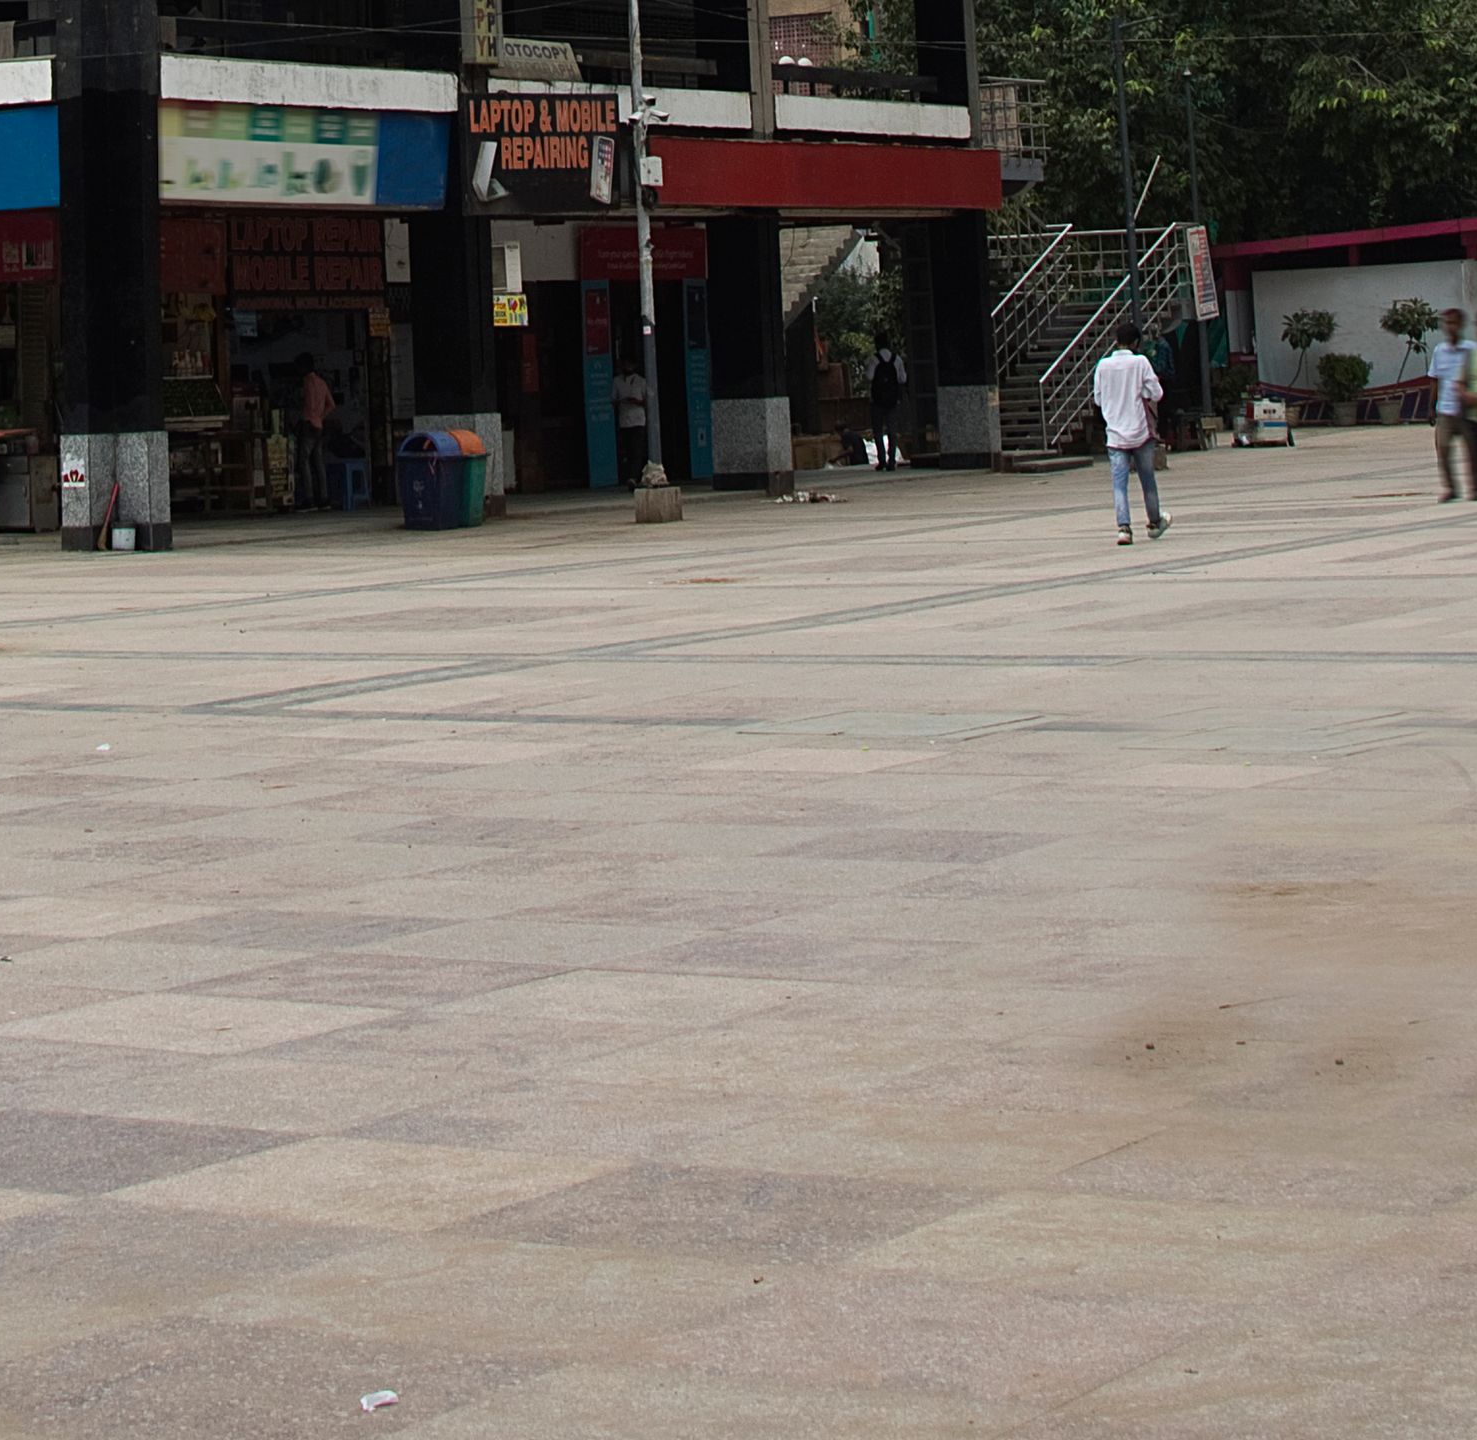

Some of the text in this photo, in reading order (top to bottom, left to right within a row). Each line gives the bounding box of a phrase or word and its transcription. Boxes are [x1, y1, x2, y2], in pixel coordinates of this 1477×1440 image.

[505, 43, 568, 59] OTOCOPY
[469, 99, 616, 132] LAPTOP & MOBILE
[501, 136, 588, 169] REPAIRING
[231, 218, 382, 252] LAPTOP REPAIR
[232, 256, 384, 290] MOBILE REPAIR
